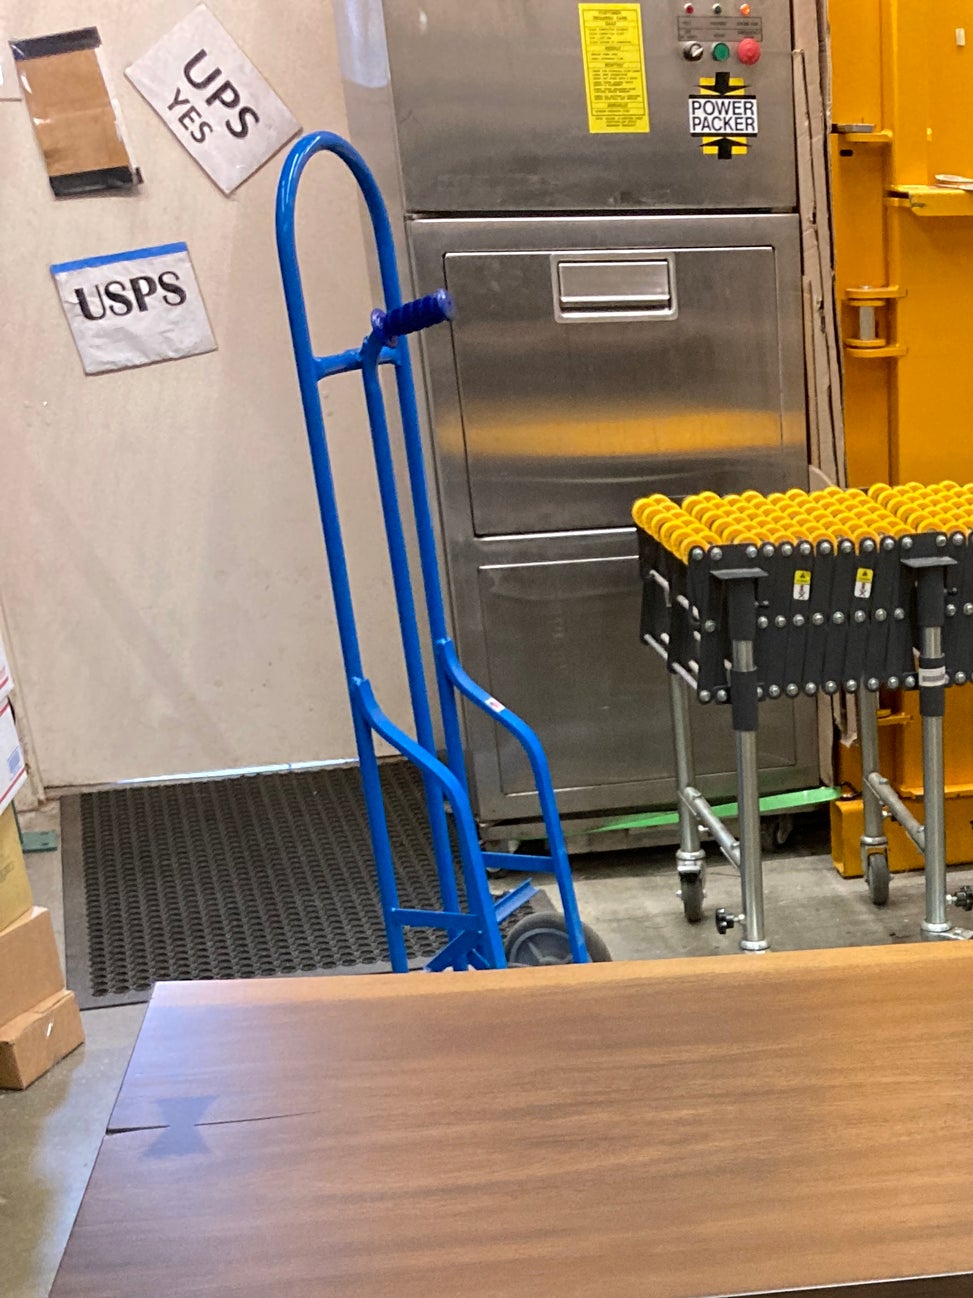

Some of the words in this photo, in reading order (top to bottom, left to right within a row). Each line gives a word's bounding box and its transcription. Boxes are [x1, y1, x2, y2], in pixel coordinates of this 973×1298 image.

[167, 88, 213, 144] YES
[183, 48, 260, 139] UPS
[691, 100, 755, 116] POWER
[692, 116, 756, 132] PACKER
[74, 271, 187, 321] USPS
